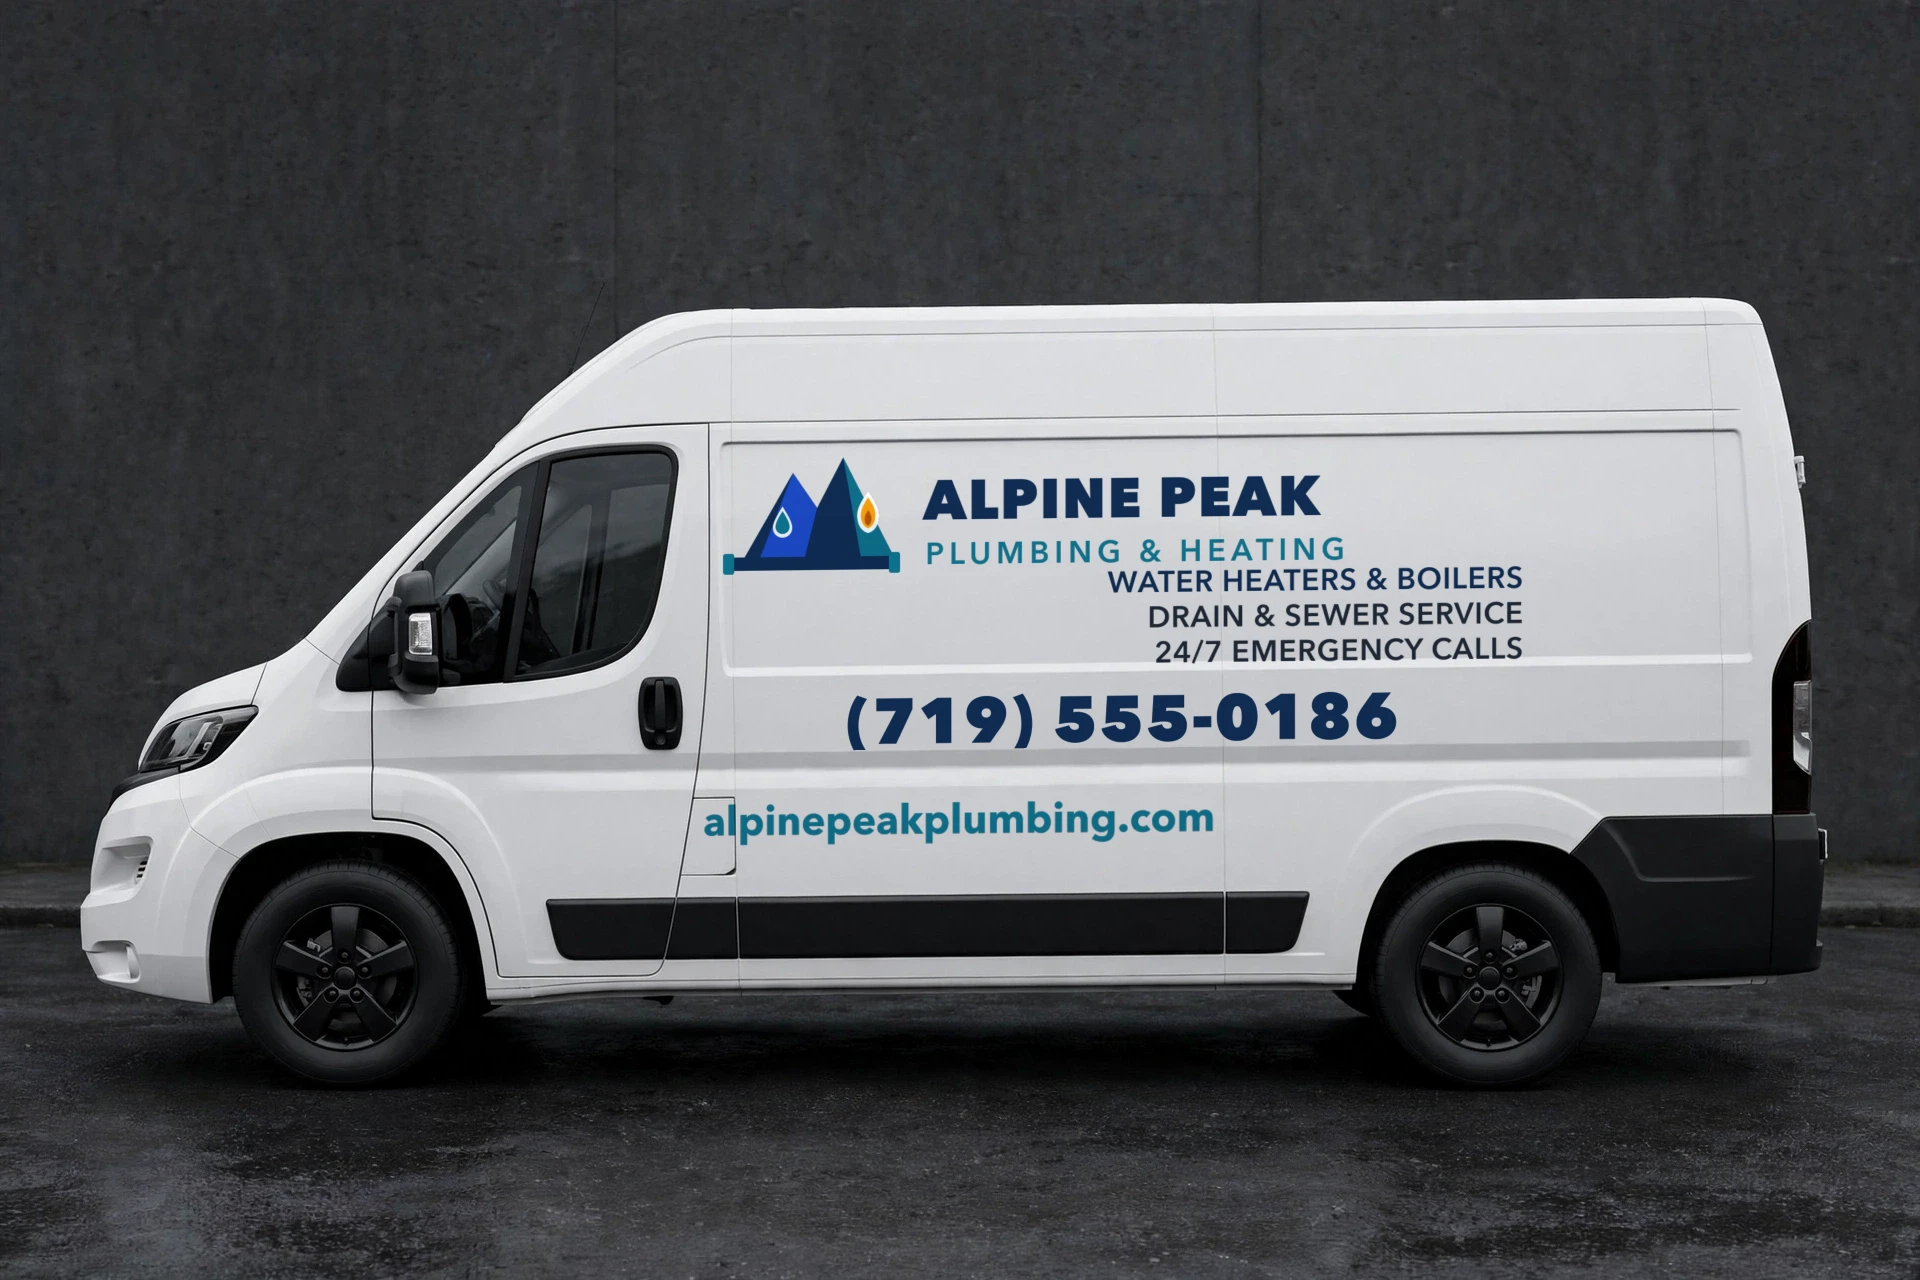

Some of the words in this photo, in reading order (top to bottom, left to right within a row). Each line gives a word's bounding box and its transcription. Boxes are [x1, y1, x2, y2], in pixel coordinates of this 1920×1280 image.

[922, 478, 1140, 520] ALPINE
[1161, 475, 1321, 517] PEAK
[927, 540, 1120, 565] PLUMBING
[1139, 539, 1161, 563] &
[1181, 537, 1344, 562] HEATING
[1108, 570, 1213, 593] WATER
[1223, 568, 1356, 592] HEATERS
[1367, 568, 1388, 590] &
[1398, 566, 1522, 590] BOILERS
[1149, 605, 1244, 628] DRAIN
[1254, 606, 1276, 627] &
[1287, 603, 1389, 626] SEWER
[1399, 602, 1522, 625] SERVICE
[1155, 640, 1221, 665] 24/7
[1233, 638, 1424, 663] EMERGENCY
[1431, 637, 1522, 661] CALLS
[847, 694, 1033, 750] (719)
[1055, 692, 1397, 744] 555-0186
[703, 801, 1214, 845] alpinepeakplumbing.com
